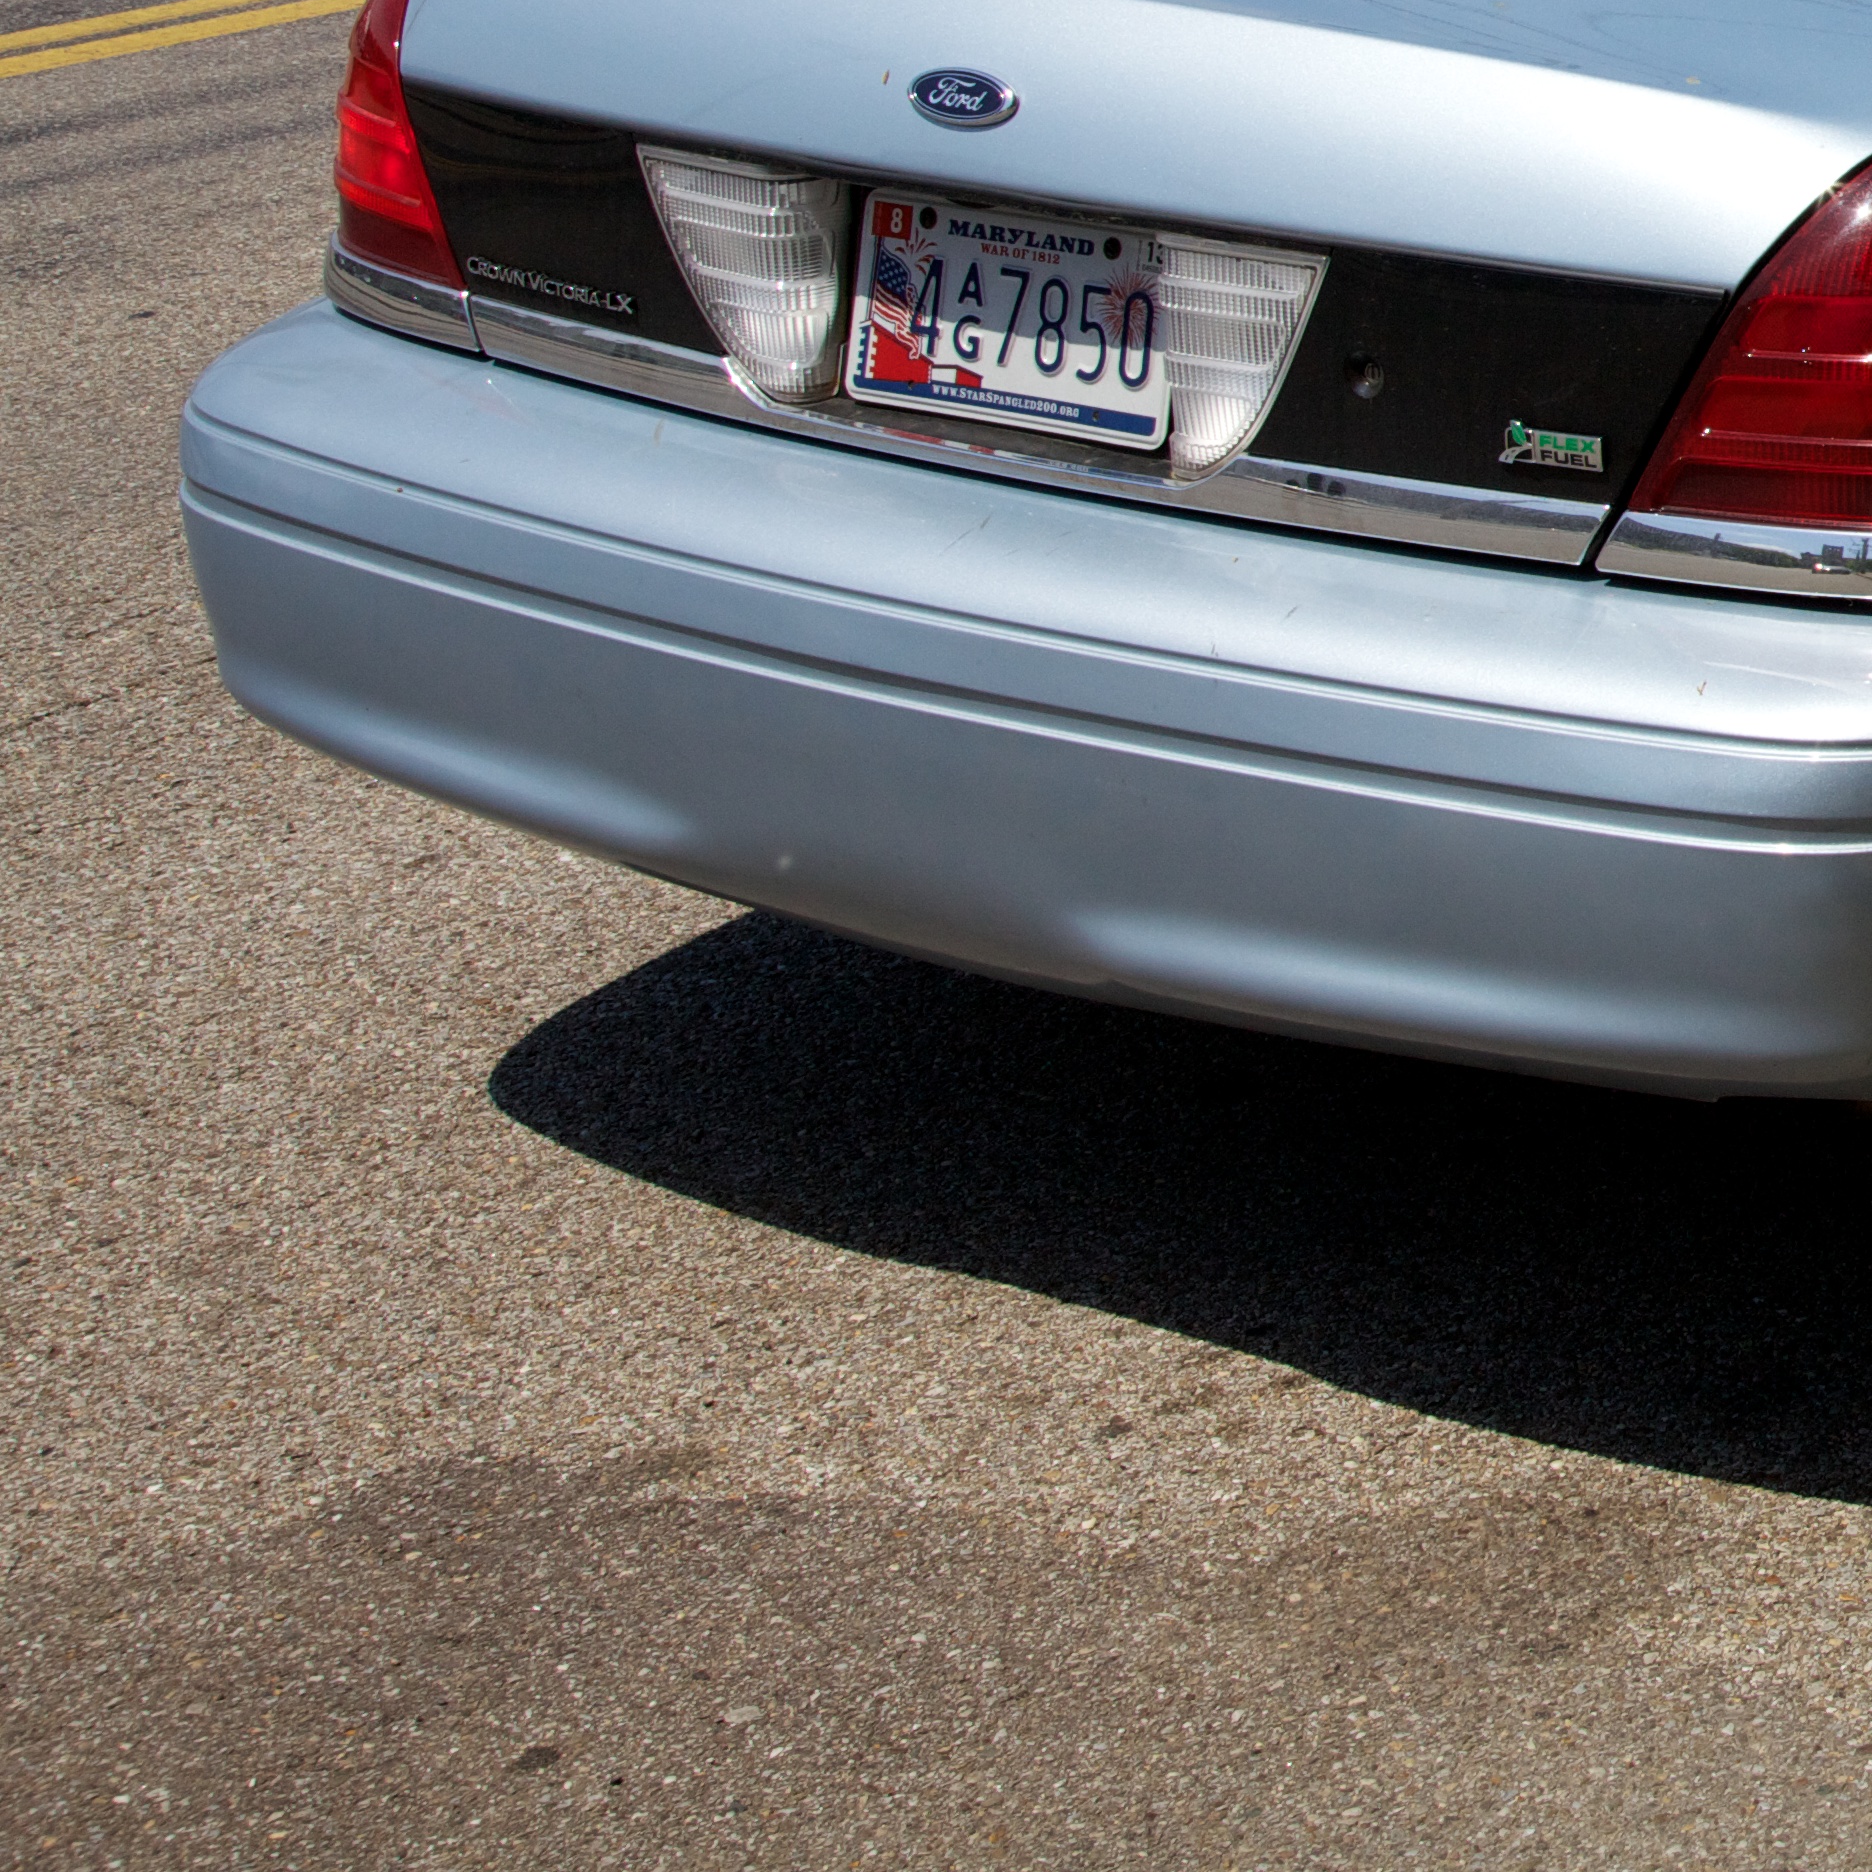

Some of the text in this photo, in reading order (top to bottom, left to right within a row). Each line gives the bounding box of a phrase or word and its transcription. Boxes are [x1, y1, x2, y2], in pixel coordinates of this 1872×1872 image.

[935, 75, 988, 112] Ford
[890, 207, 903, 233] 8
[947, 218, 1095, 257] MARYLAND
[980, 242, 1060, 265] WAR OF 1812
[467, 256, 633, 314] CROWN VICTORIA LX
[1539, 434, 1597, 454] FLEX
[1540, 449, 1598, 469] FUEL
